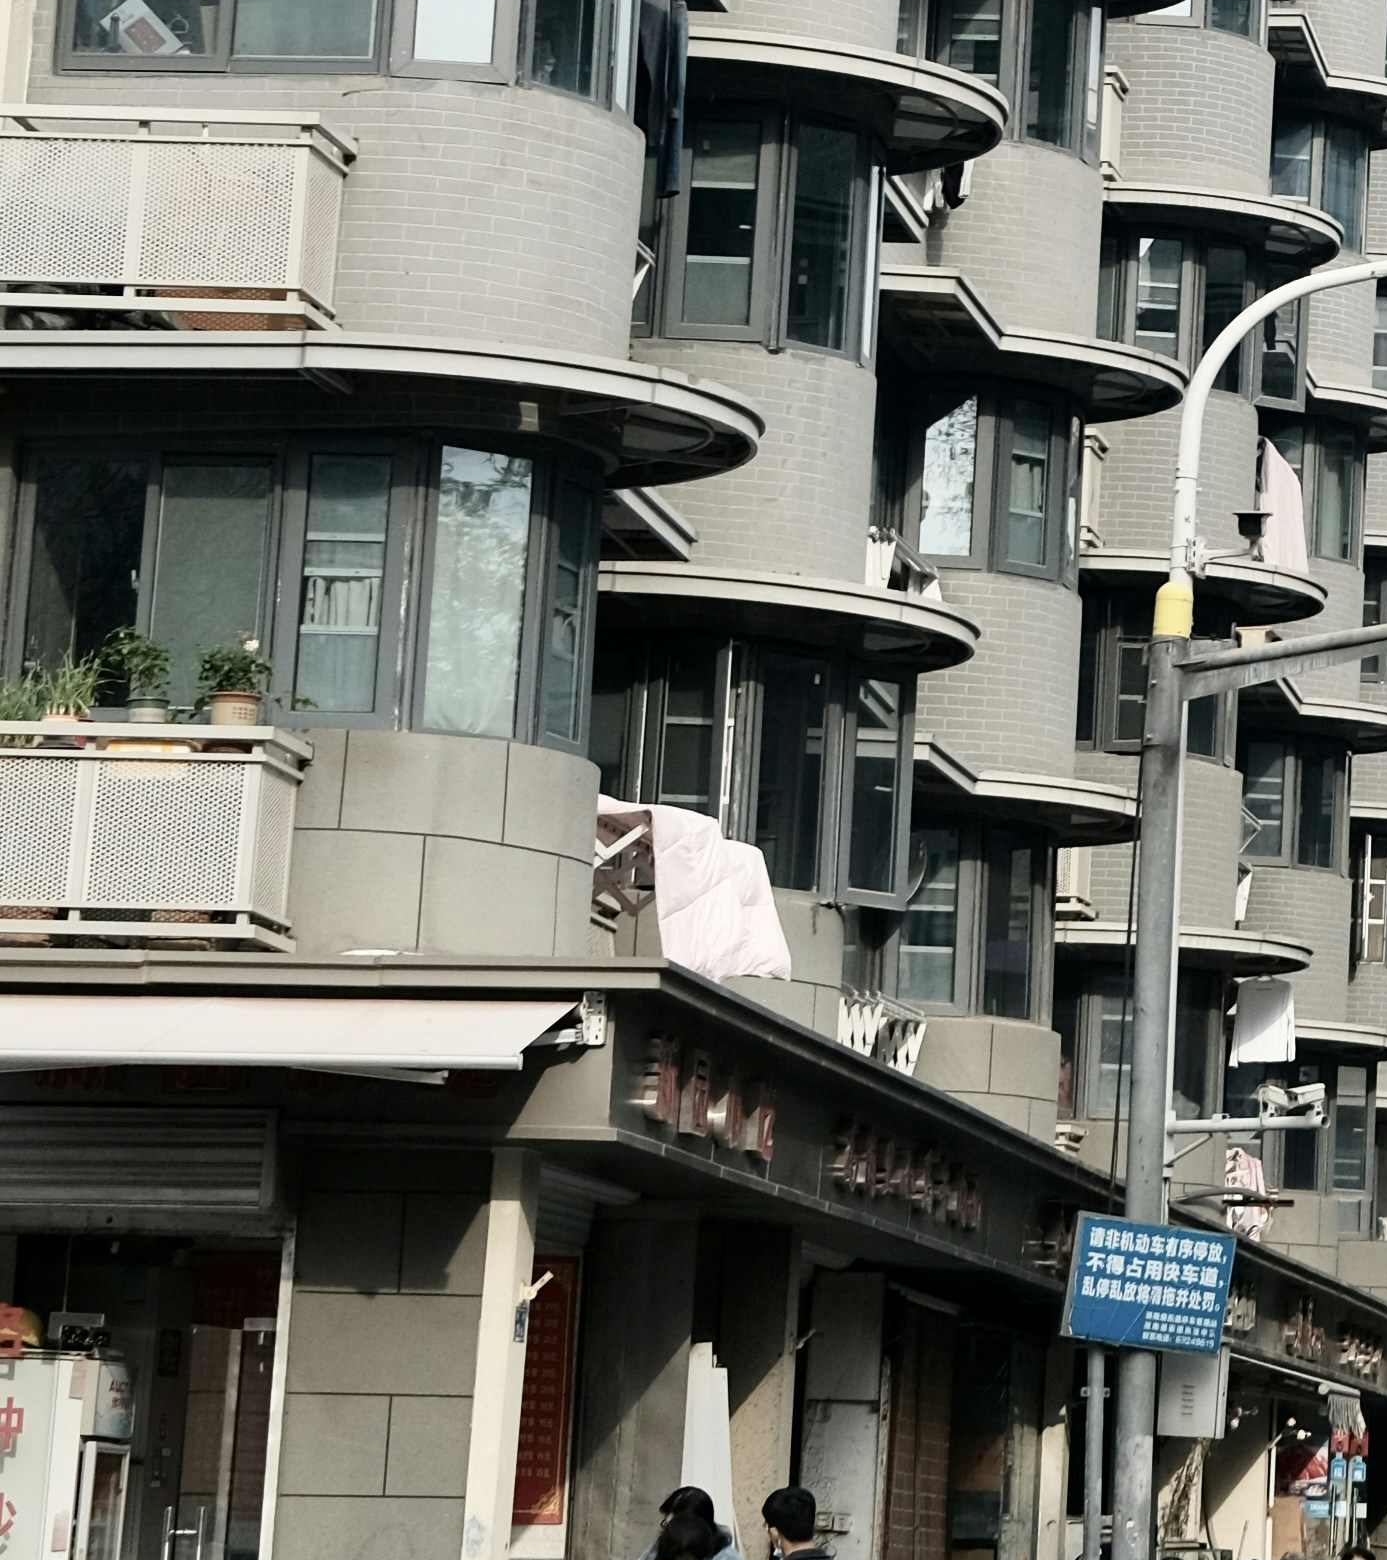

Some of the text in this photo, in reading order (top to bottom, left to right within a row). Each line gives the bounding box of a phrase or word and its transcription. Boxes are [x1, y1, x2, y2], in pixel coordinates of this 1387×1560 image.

[1089, 1226, 1227, 1264] 请非机动车有序停放，
[1086, 1252, 1224, 1288] 不得占用快车道，
